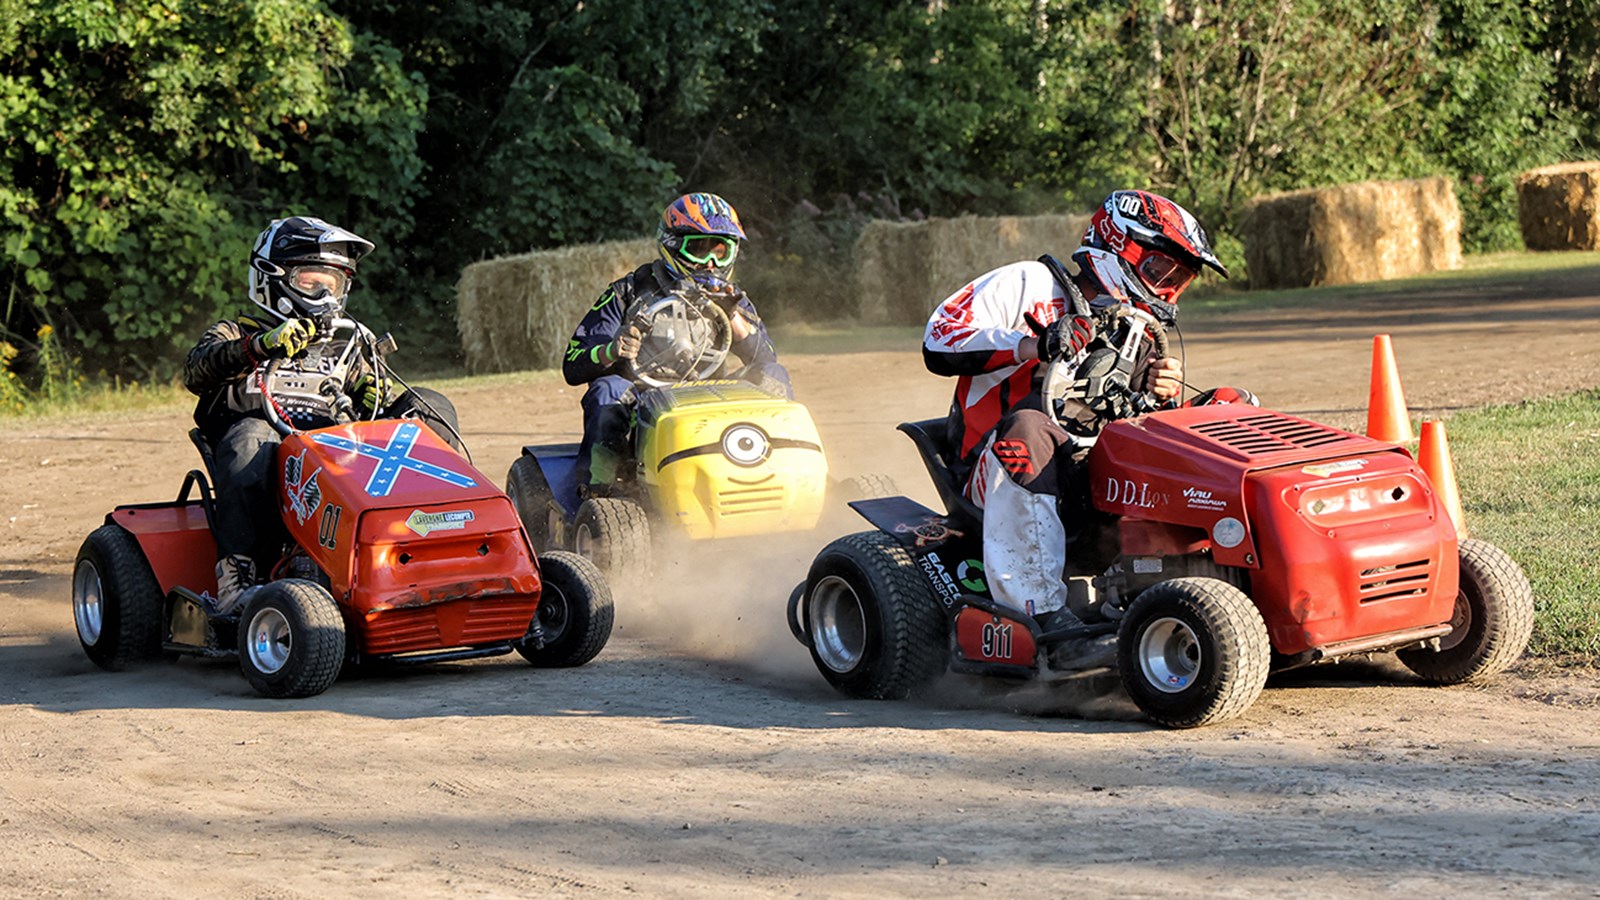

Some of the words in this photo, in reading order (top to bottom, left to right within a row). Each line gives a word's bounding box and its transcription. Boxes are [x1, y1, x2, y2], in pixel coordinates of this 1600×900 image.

[1119, 196, 1141, 216] 00
[319, 502, 342, 550] 01
[918, 555, 953, 608] TRANSPO
[982, 622, 1013, 659] 911
